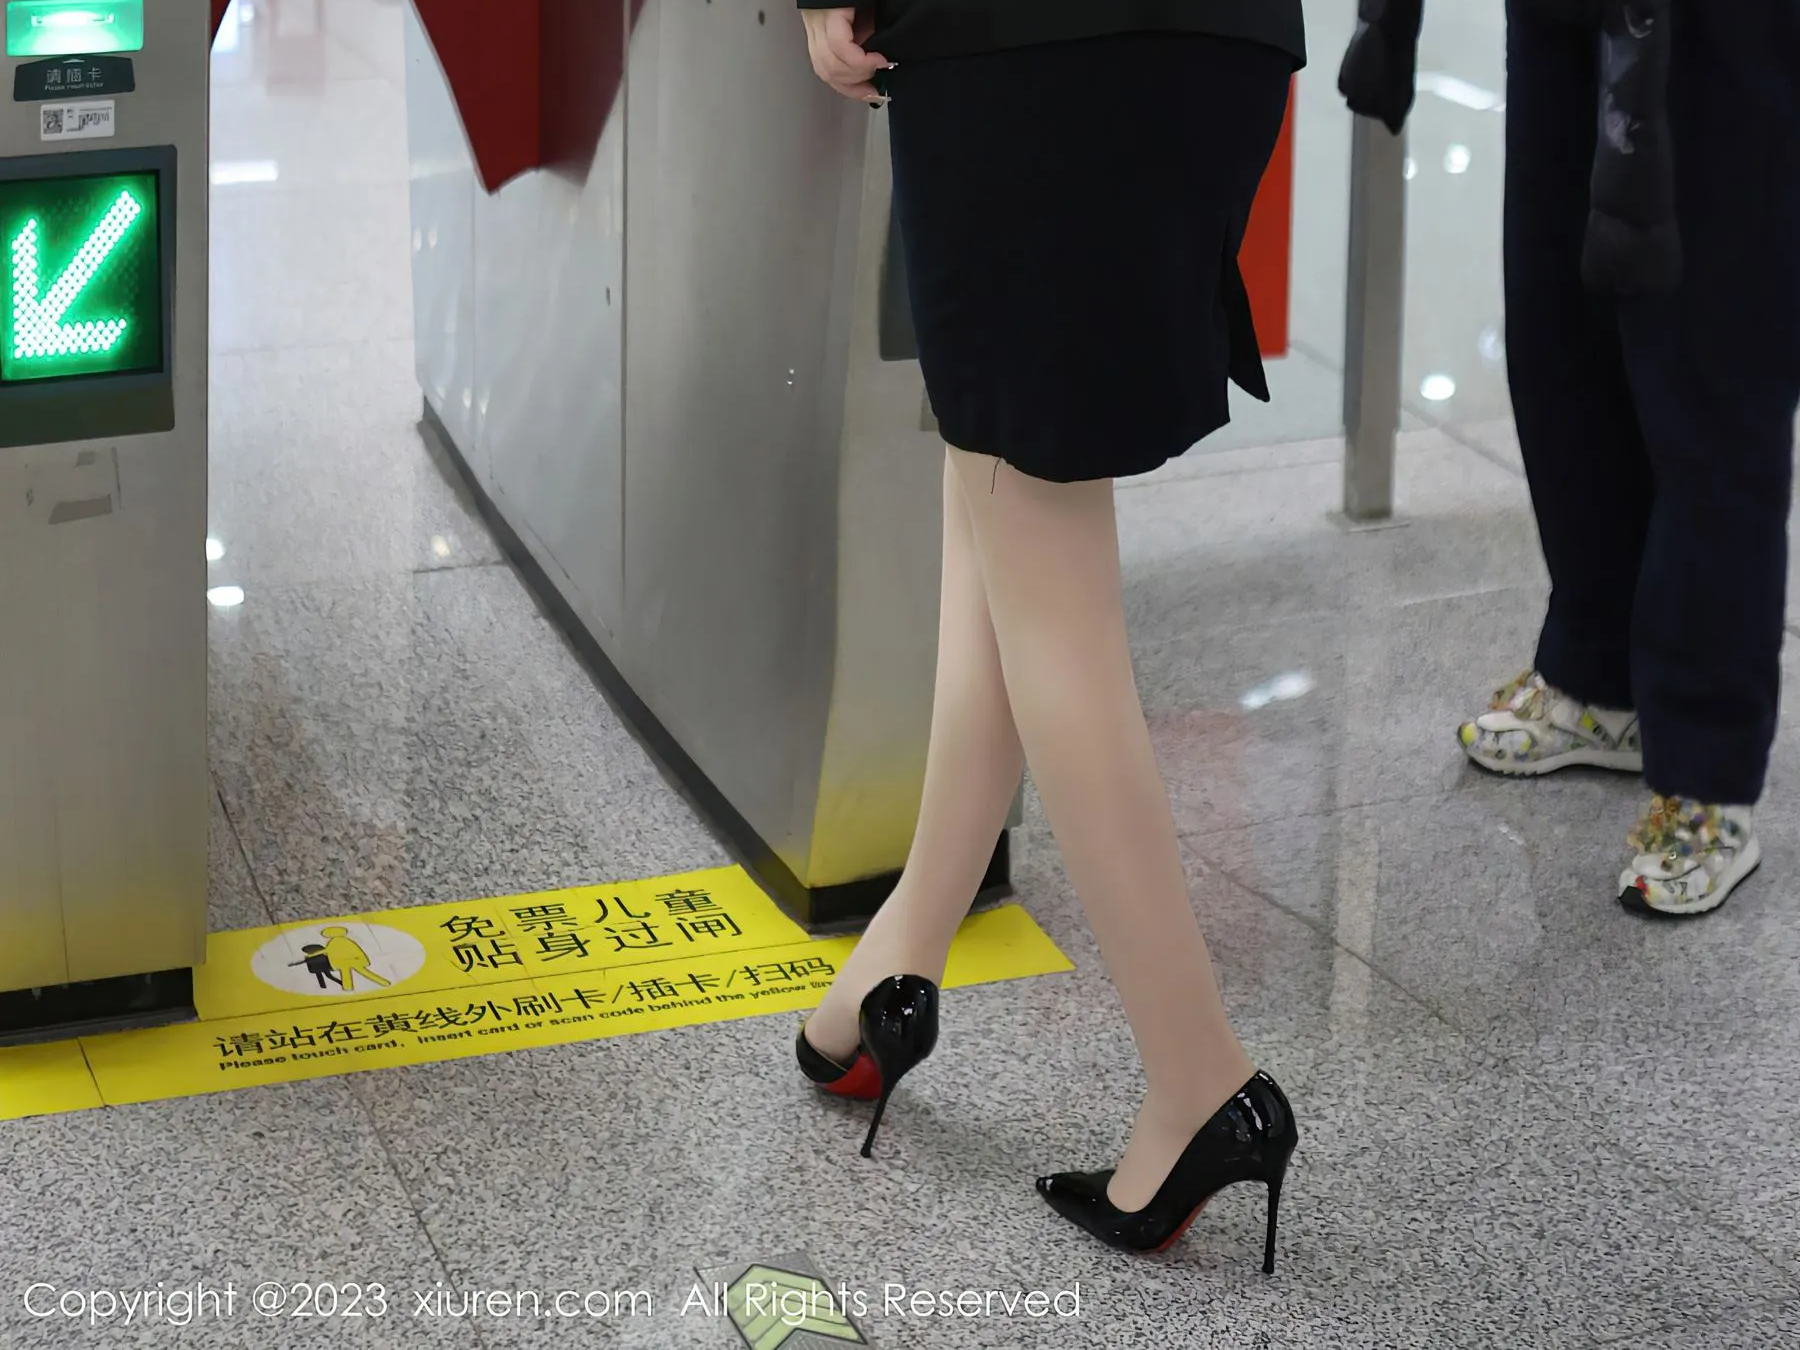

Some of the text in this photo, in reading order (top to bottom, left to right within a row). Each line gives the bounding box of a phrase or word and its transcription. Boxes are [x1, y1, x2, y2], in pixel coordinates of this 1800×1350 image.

[440, 889, 723, 942] 免票儿童
[452, 912, 743, 972] 贴身过闸
[213, 957, 836, 1057] 请站在黄线外刷卡/插卡/扫码
[219, 1055, 287, 1071] Please
[291, 1046, 349, 1062] touch
[477, 1023, 520, 1036] card
[524, 1020, 543, 1030] or
[549, 1013, 595, 1026] scan
[599, 1005, 645, 1019] code
[648, 996, 713, 1012] behind
[715, 992, 745, 1002] the
[750, 984, 806, 999] yellow
